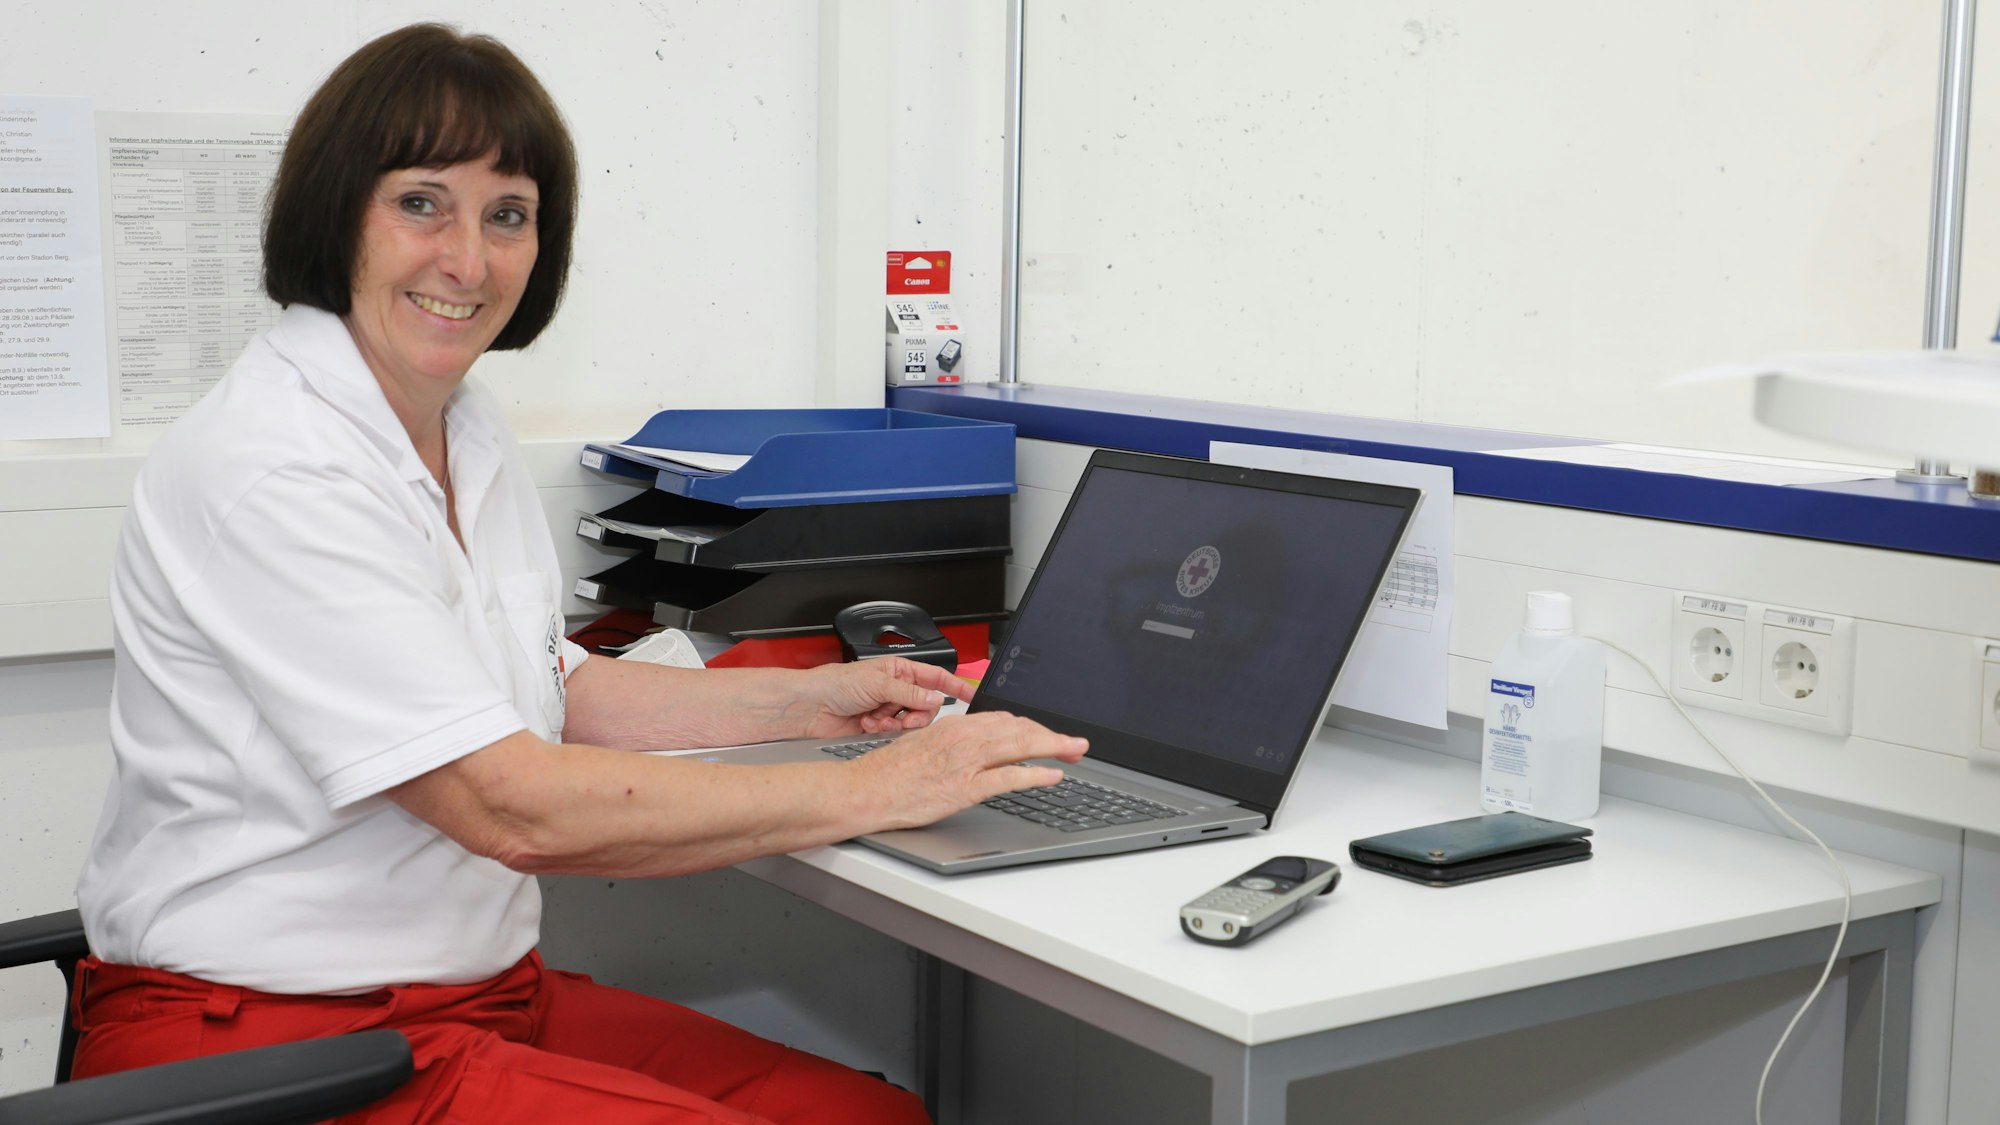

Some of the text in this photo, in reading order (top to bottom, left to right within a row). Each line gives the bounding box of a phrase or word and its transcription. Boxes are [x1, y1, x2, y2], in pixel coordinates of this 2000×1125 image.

[905, 278, 931, 286] Canon
[896, 304, 914, 313] 545
[905, 338, 927, 346] PIXMA
[907, 352, 925, 363] 545
[1186, 547, 1219, 570] DEUTSCHES
[1189, 575, 1214, 595] KREUZ
